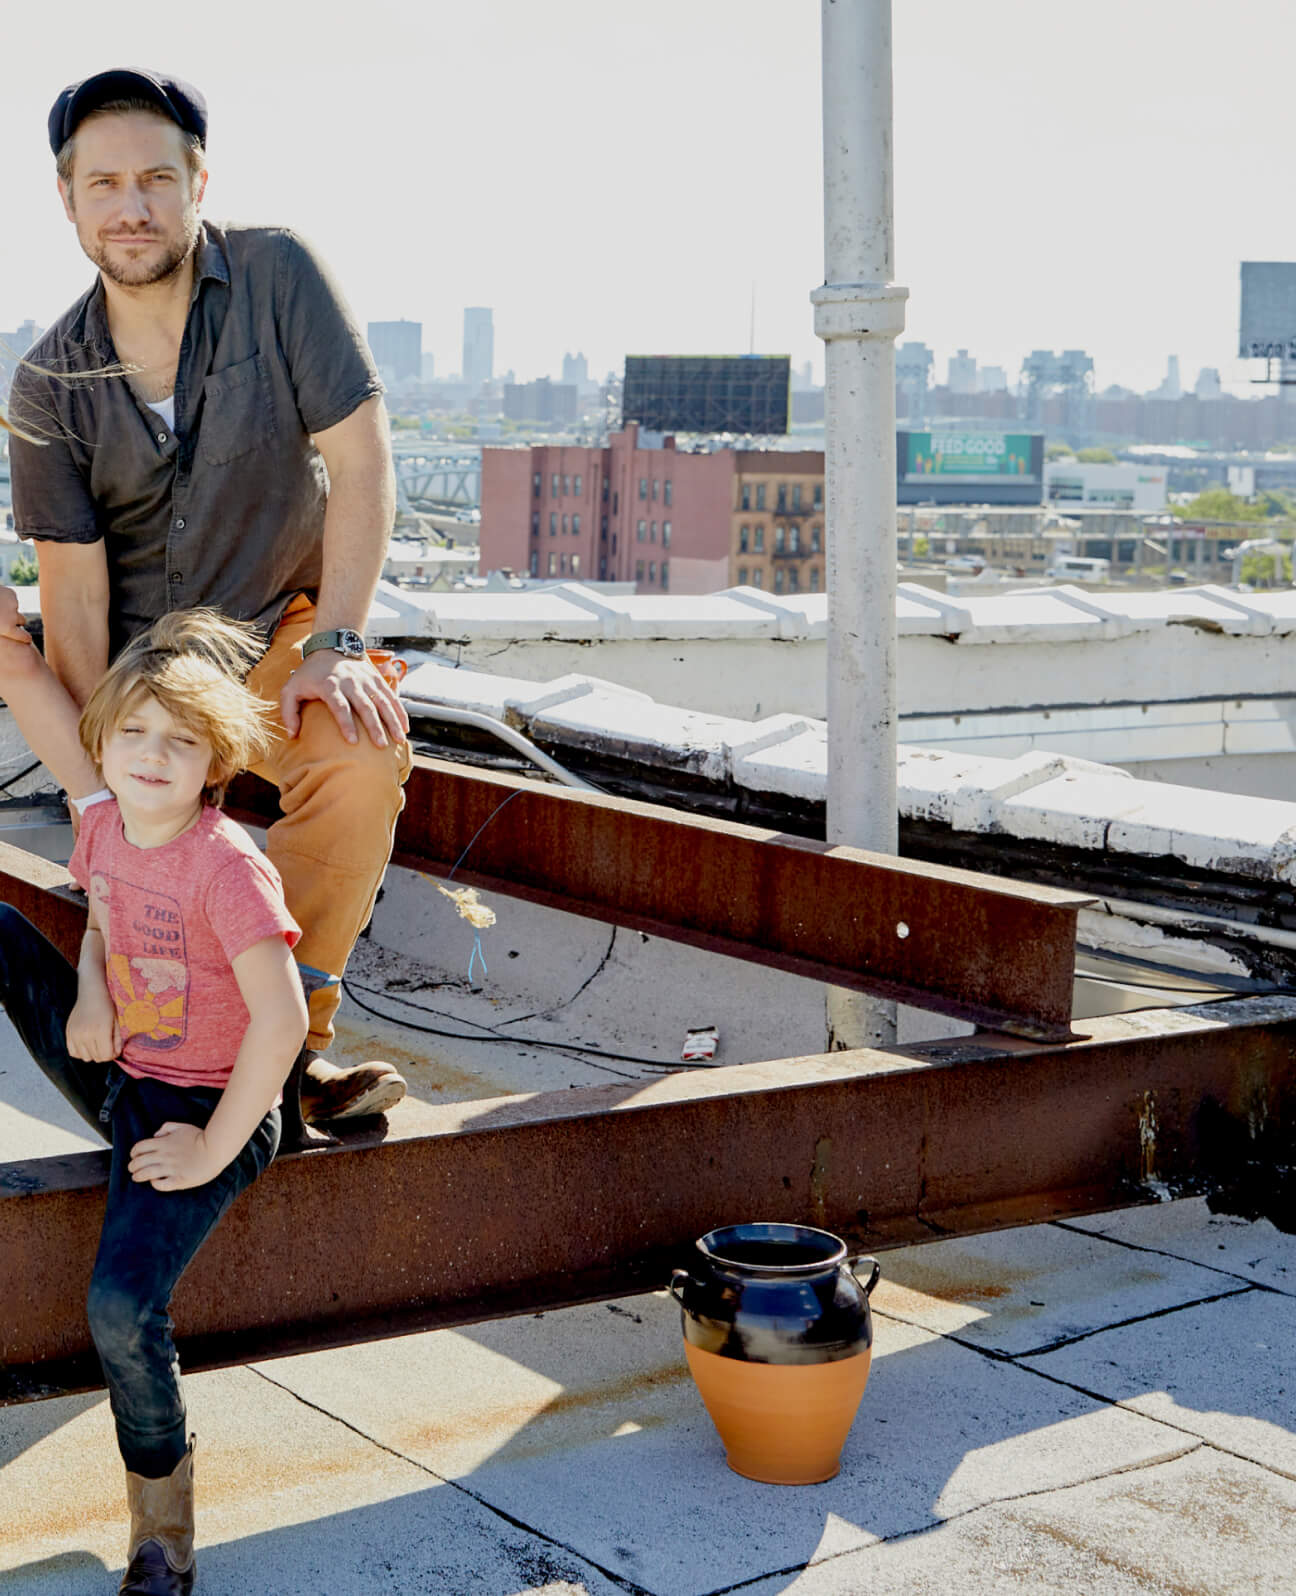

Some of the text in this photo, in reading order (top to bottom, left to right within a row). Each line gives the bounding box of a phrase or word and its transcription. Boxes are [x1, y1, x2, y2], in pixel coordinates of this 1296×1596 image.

[144, 904, 180, 924] THE
[133, 919, 180, 941] GOOD
[144, 943, 182, 960] LIFE
